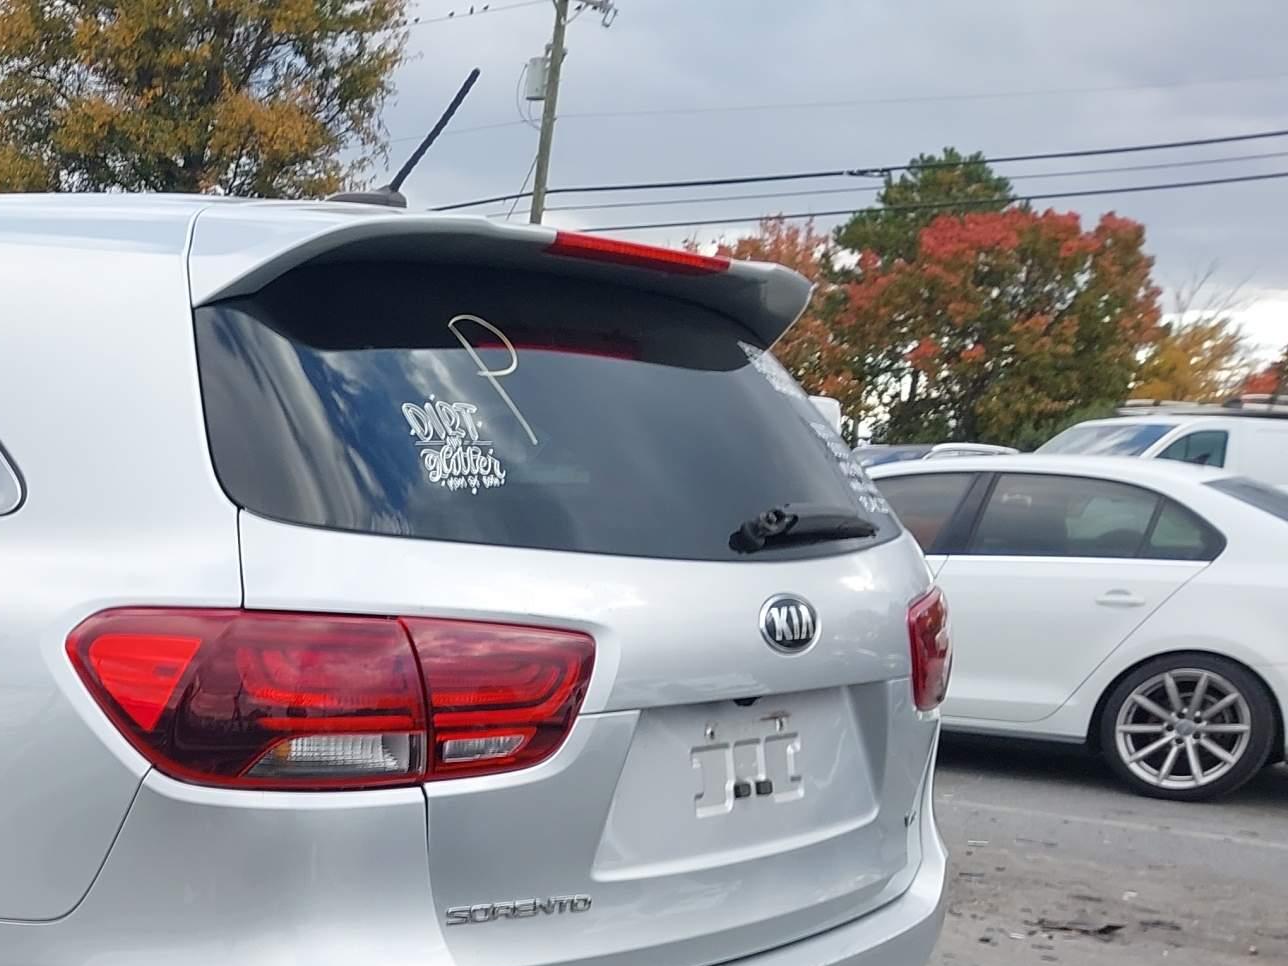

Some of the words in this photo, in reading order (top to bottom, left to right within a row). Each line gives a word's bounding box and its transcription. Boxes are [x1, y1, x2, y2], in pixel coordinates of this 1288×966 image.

[448, 314, 538, 446] P
[769, 604, 814, 641] KIA
[446, 894, 592, 926] SORENTO
